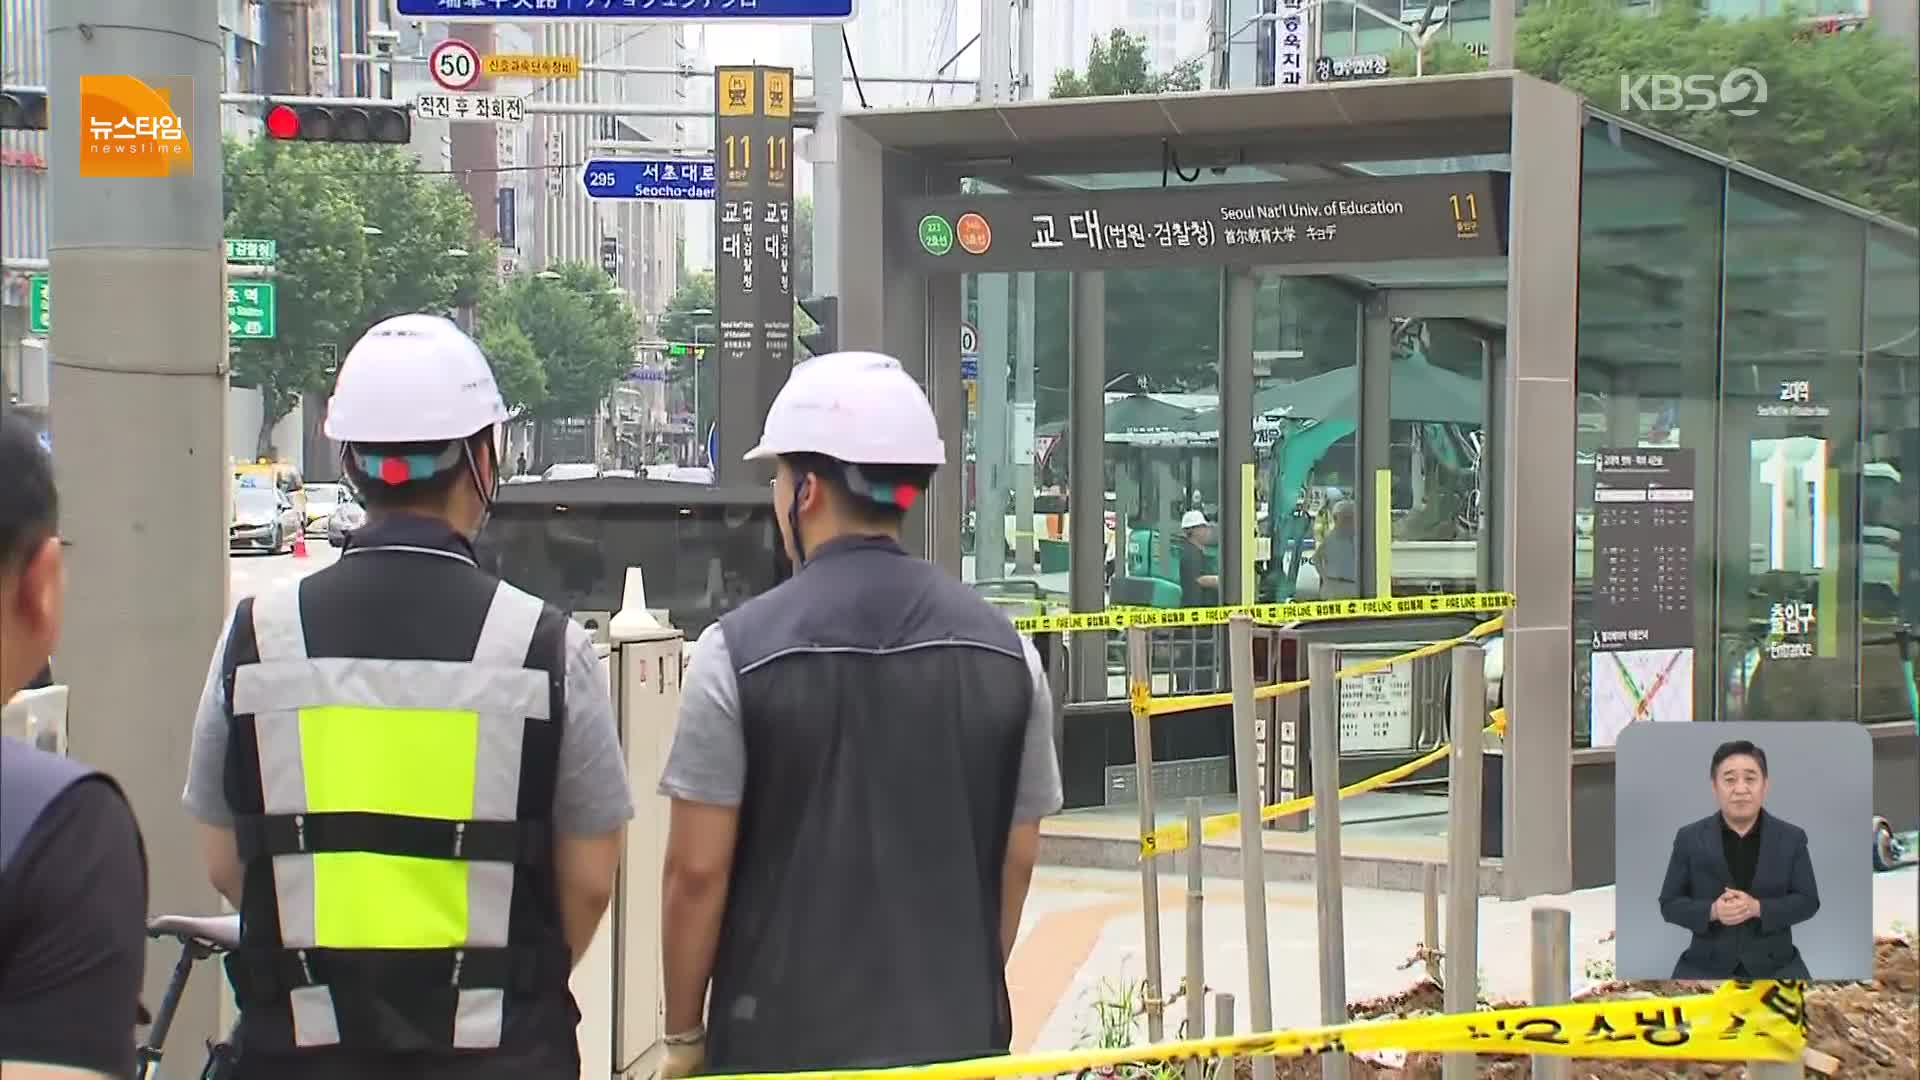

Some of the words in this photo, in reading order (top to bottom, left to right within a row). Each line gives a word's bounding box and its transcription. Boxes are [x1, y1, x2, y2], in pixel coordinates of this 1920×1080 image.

[440, 55, 470, 77] 50
[420, 96, 449, 118] 직진
[455, 97, 469, 118] 후
[476, 97, 522, 121] 좌회전
[725, 135, 750, 169] 11
[767, 135, 787, 169] 11
[589, 172, 615, 187] 295
[642, 164, 716, 181] 서초대로
[1220, 206, 1255, 221] Seoul
[1257, 205, 1287, 220] Nat'l
[1289, 203, 1322, 218] Univ.
[1323, 201, 1338, 216] of
[1339, 199, 1404, 216] Education
[1449, 194, 1477, 220] 11
[722, 202, 741, 259] 교대
[764, 202, 780, 260] 교대
[1031, 209, 1103, 250] 교대
[1759, 440, 1827, 570] 11
